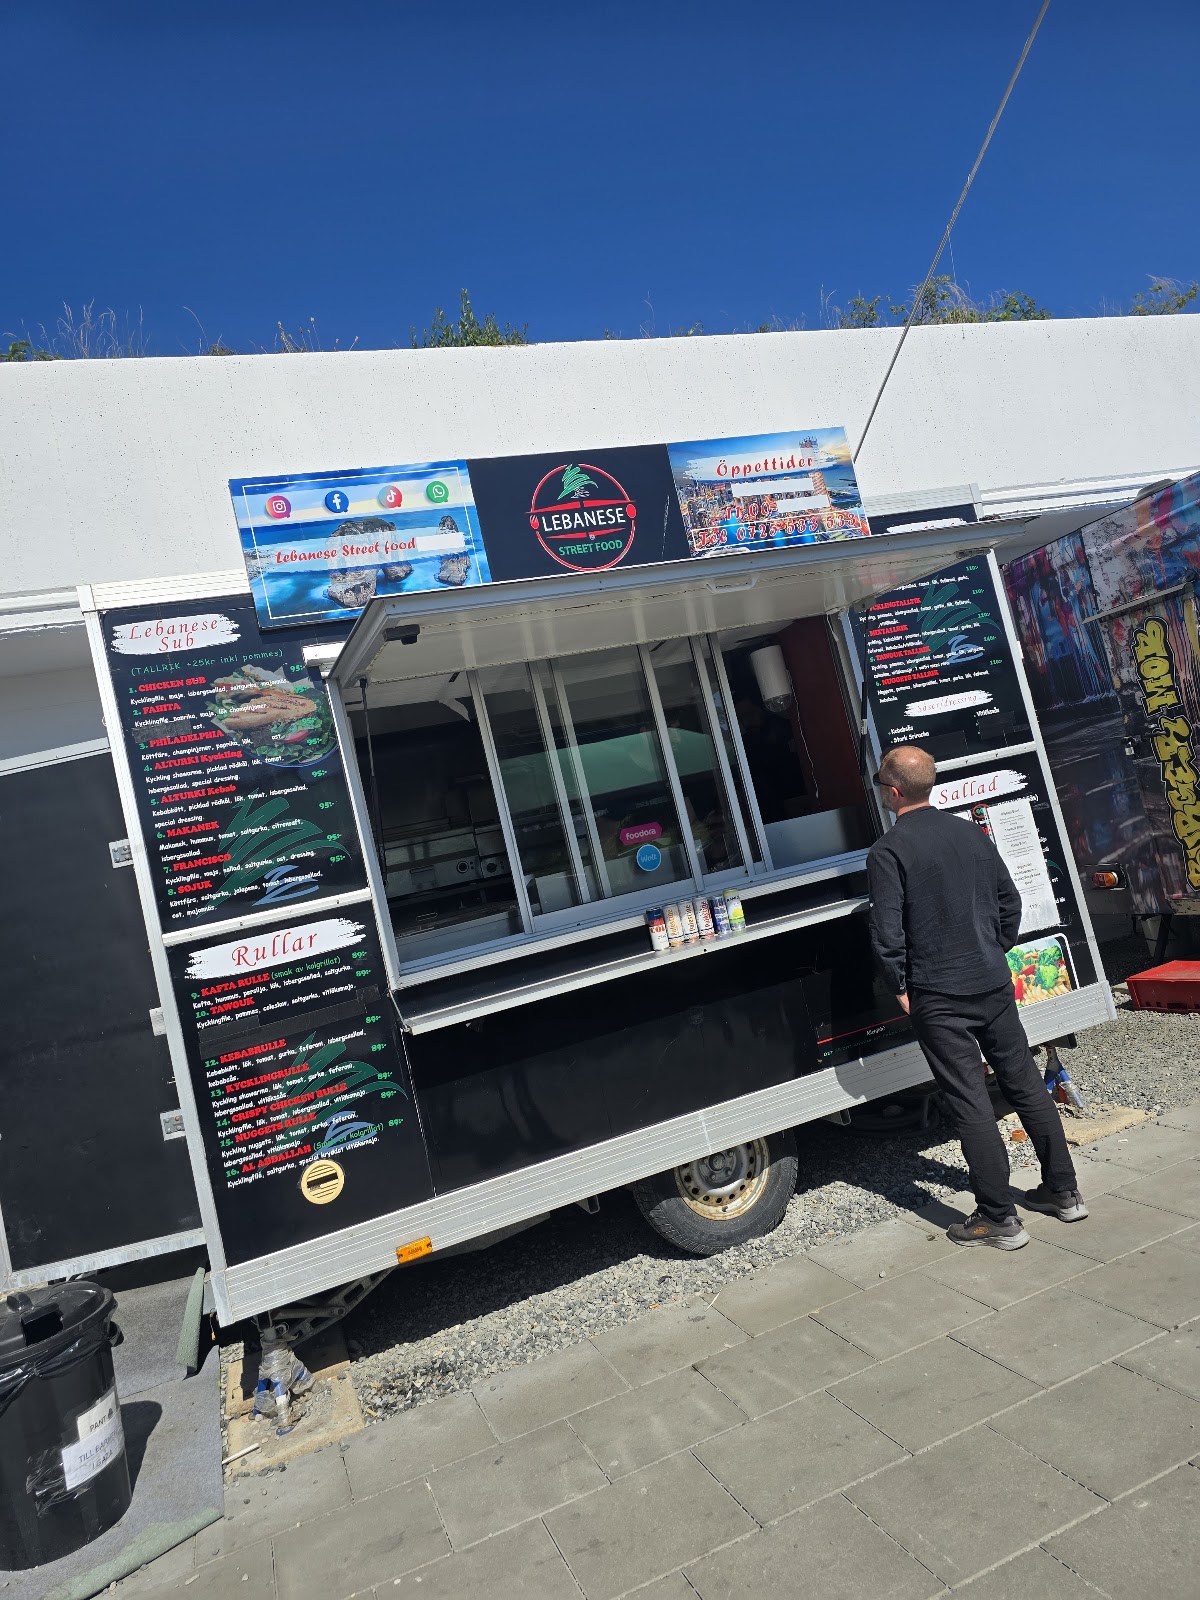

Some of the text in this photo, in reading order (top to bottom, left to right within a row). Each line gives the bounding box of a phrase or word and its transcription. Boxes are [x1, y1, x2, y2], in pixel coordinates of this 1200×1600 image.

[716, 455, 813, 478] Öppettider
[541, 507, 626, 532] LEBANESE
[826, 513, 857, 529] 533
[276, 537, 416, 564] Lebanese Street food
[558, 539, 623, 556] STREET FOOD
[128, 618, 217, 640] Lebanese
[158, 632, 195, 652] Sub
[131, 662, 181, 677] (TALLRIK
[220, 654, 238, 664] inkl
[242, 649, 283, 662] pommes)
[875, 651, 904, 661] TAWOUK
[903, 646, 931, 656] TALLRIK
[1135, 616, 1182, 713] MOB
[138, 680, 184, 692] CHICKEN
[185, 676, 206, 686] SUB
[881, 674, 912, 685] NUGGETS
[911, 669, 939, 680] TALLRIK
[143, 703, 181, 714] FAHITA
[139, 730, 224, 750] 3. PHILADELPHIA
[143, 764, 153, 772] 4.
[155, 756, 199, 769] ALTURKI
[200, 750, 243, 763] Kyckling
[145, 774, 171, 784] Kyckling
[191, 778, 212, 788] special
[150, 798, 160, 806] 5.
[161, 789, 206, 803] ALTURKI
[207, 784, 236, 795] Kebab
[938, 775, 999, 805] Sallad
[154, 818, 176, 829] special
[156, 831, 166, 839] 6.
[167, 821, 219, 837] MAKANEK
[625, 828, 656, 841] foodora
[162, 866, 172, 874] 7.
[173, 853, 231, 871] FRANCISCO
[640, 853, 657, 863] Wolt
[167, 888, 177, 896] 8.
[178, 880, 212, 894] SOJUK
[231, 932, 317, 967] Rullar
[190, 992, 200, 1000] 9.
[201, 982, 237, 997] KAFTA
[237, 973, 270, 987] RULLE
[271, 967, 293, 981] (smak
[305, 955, 341, 971] kolgrillat)
[195, 1010, 210, 1019] 10.
[210, 997, 255, 1014] TAWOUK
[204, 1059, 219, 1068] 12.
[220, 1039, 286, 1063] KEBABRULLE
[210, 1089, 225, 1098] 13.
[226, 1063, 309, 1093] KYCKLINGRULLE
[211, 1096, 238, 1108] Kyckling
[216, 1118, 231, 1128] 14.
[231, 1106, 267, 1122] CRISPY
[270, 1092, 315, 1111] CHICKEN
[316, 1083, 347, 1098] RULLE
[220, 1138, 234, 1148] 15.
[235, 1122, 283, 1142] NUGGETS
[284, 1112, 316, 1128] RULLE
[221, 1146, 247, 1158] Kyckling
[225, 1168, 240, 1178] 16.
[242, 1162, 256, 1173] AL
[257, 1144, 311, 1168] ABDALLAH
[89, 1414, 107, 1432] PANT
[79, 1449, 95, 1463] TILL
